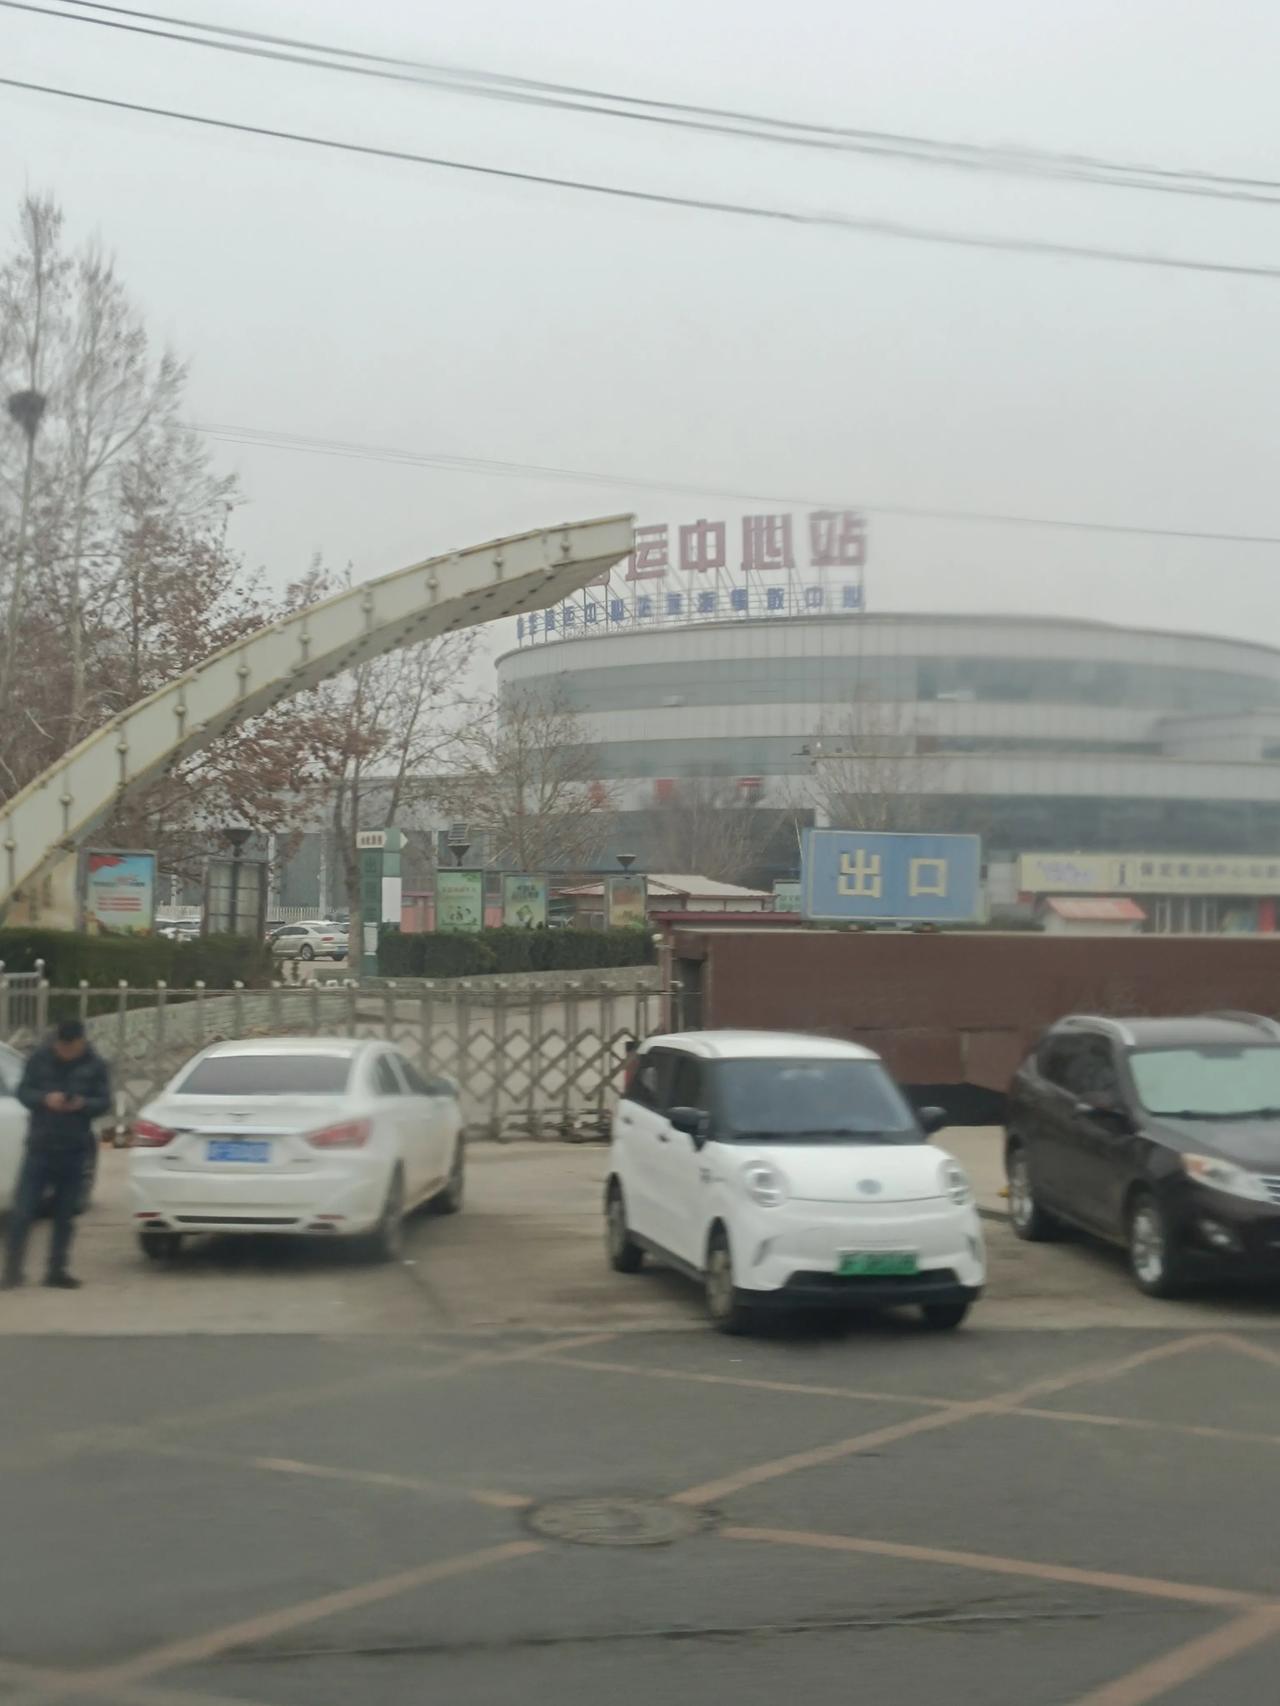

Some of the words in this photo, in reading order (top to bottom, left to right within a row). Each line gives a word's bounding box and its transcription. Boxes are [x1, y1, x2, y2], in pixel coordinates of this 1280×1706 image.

[590, 510, 867, 585] 运中心站
[838, 849, 947, 897] 出口
